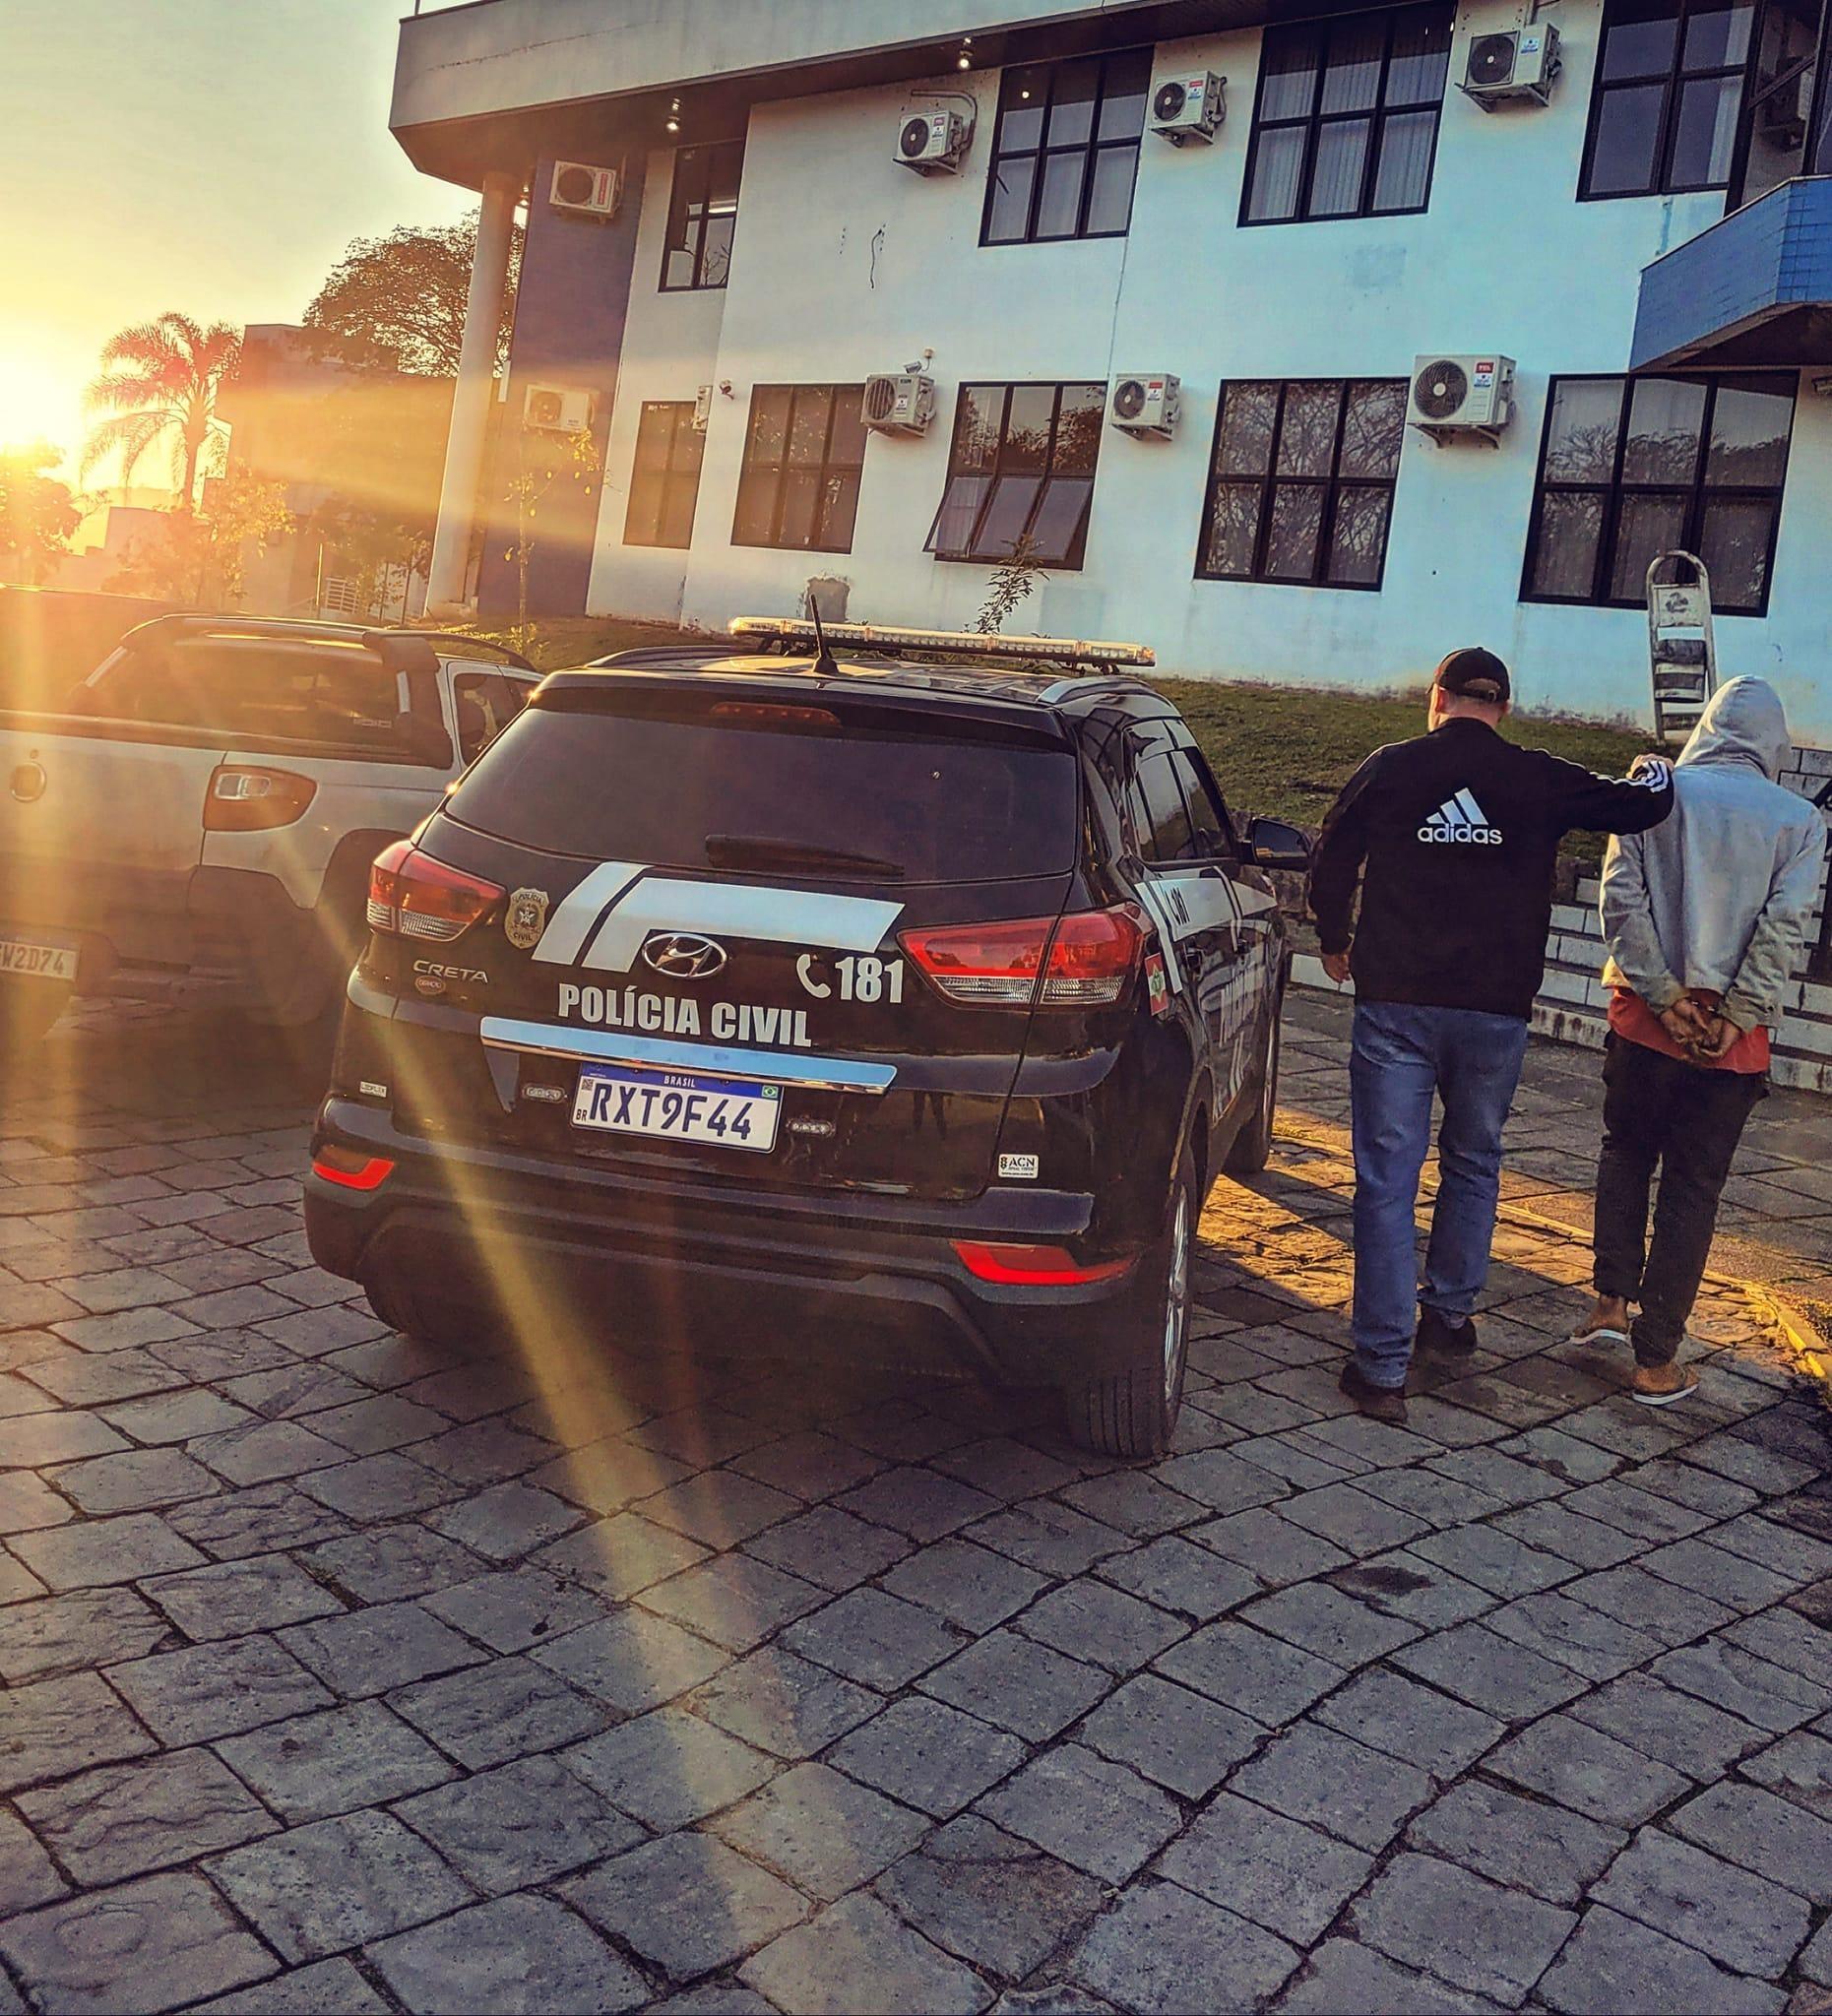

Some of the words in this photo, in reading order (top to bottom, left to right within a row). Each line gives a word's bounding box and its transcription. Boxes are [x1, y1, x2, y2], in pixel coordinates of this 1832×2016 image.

[1418, 823, 1503, 845] adidas
[513, 931, 533, 941] CIVIL
[0, 943, 65, 976] W2D74
[413, 959, 488, 984] CRETA
[835, 956, 904, 1003] 181
[558, 982, 701, 1037] POLÍCIA
[711, 1002, 812, 1047] CIVIL
[663, 1075, 696, 1088] BRASIL
[576, 1108, 588, 1122] BR
[590, 1083, 754, 1140] RXT9F44
[1009, 1157, 1035, 1167] ACN
